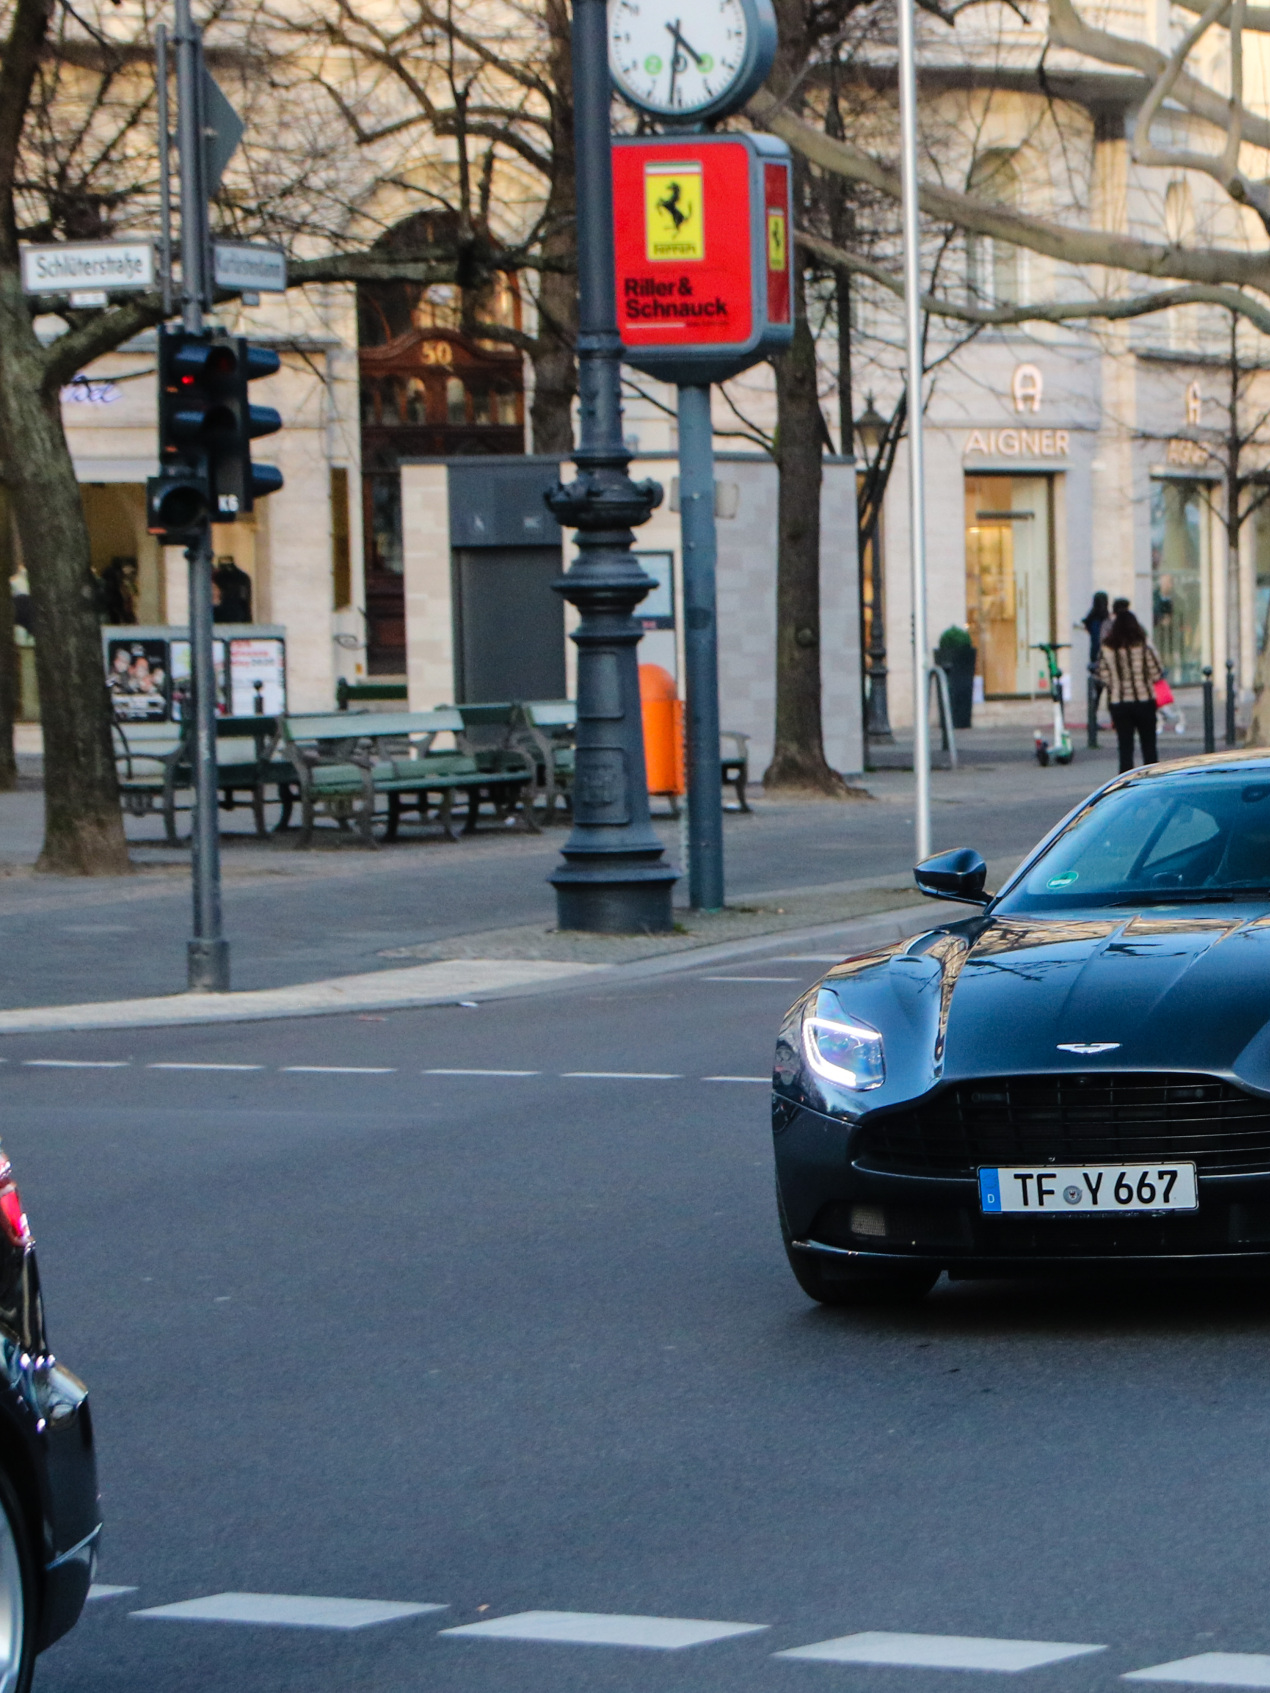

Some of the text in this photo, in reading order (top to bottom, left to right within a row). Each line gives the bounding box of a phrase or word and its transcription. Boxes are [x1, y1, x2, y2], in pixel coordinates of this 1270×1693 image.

[624, 276, 693, 297] Riller &
[625, 297, 729, 319] Schnauck
[422, 340, 453, 366] 50
[964, 428, 1071, 457] AIGNER
[218, 494, 239, 512] K6
[987, 1170, 1178, 1207] D TF Y 667
